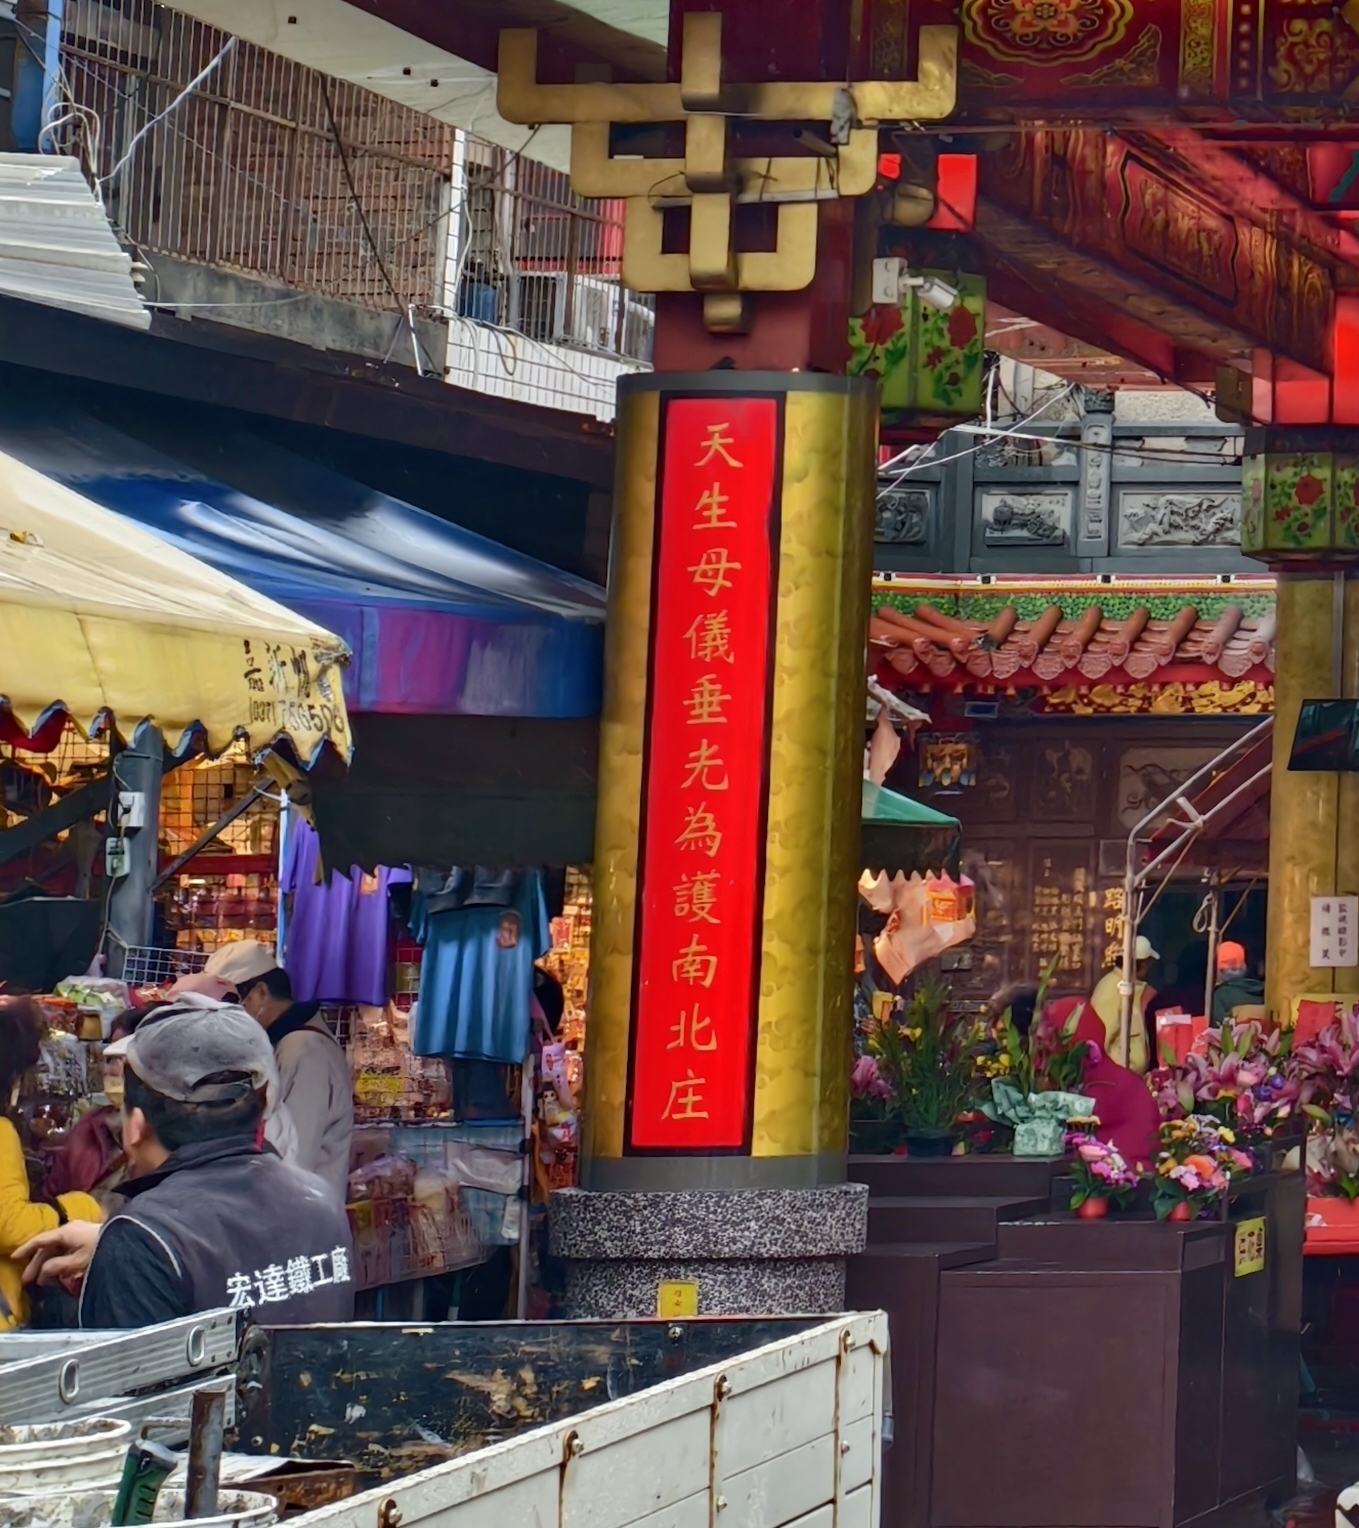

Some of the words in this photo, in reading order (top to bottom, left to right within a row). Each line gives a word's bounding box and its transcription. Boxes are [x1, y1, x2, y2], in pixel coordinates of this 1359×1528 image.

[661, 421, 743, 1121] 天生母儀垂光為護南北庄
